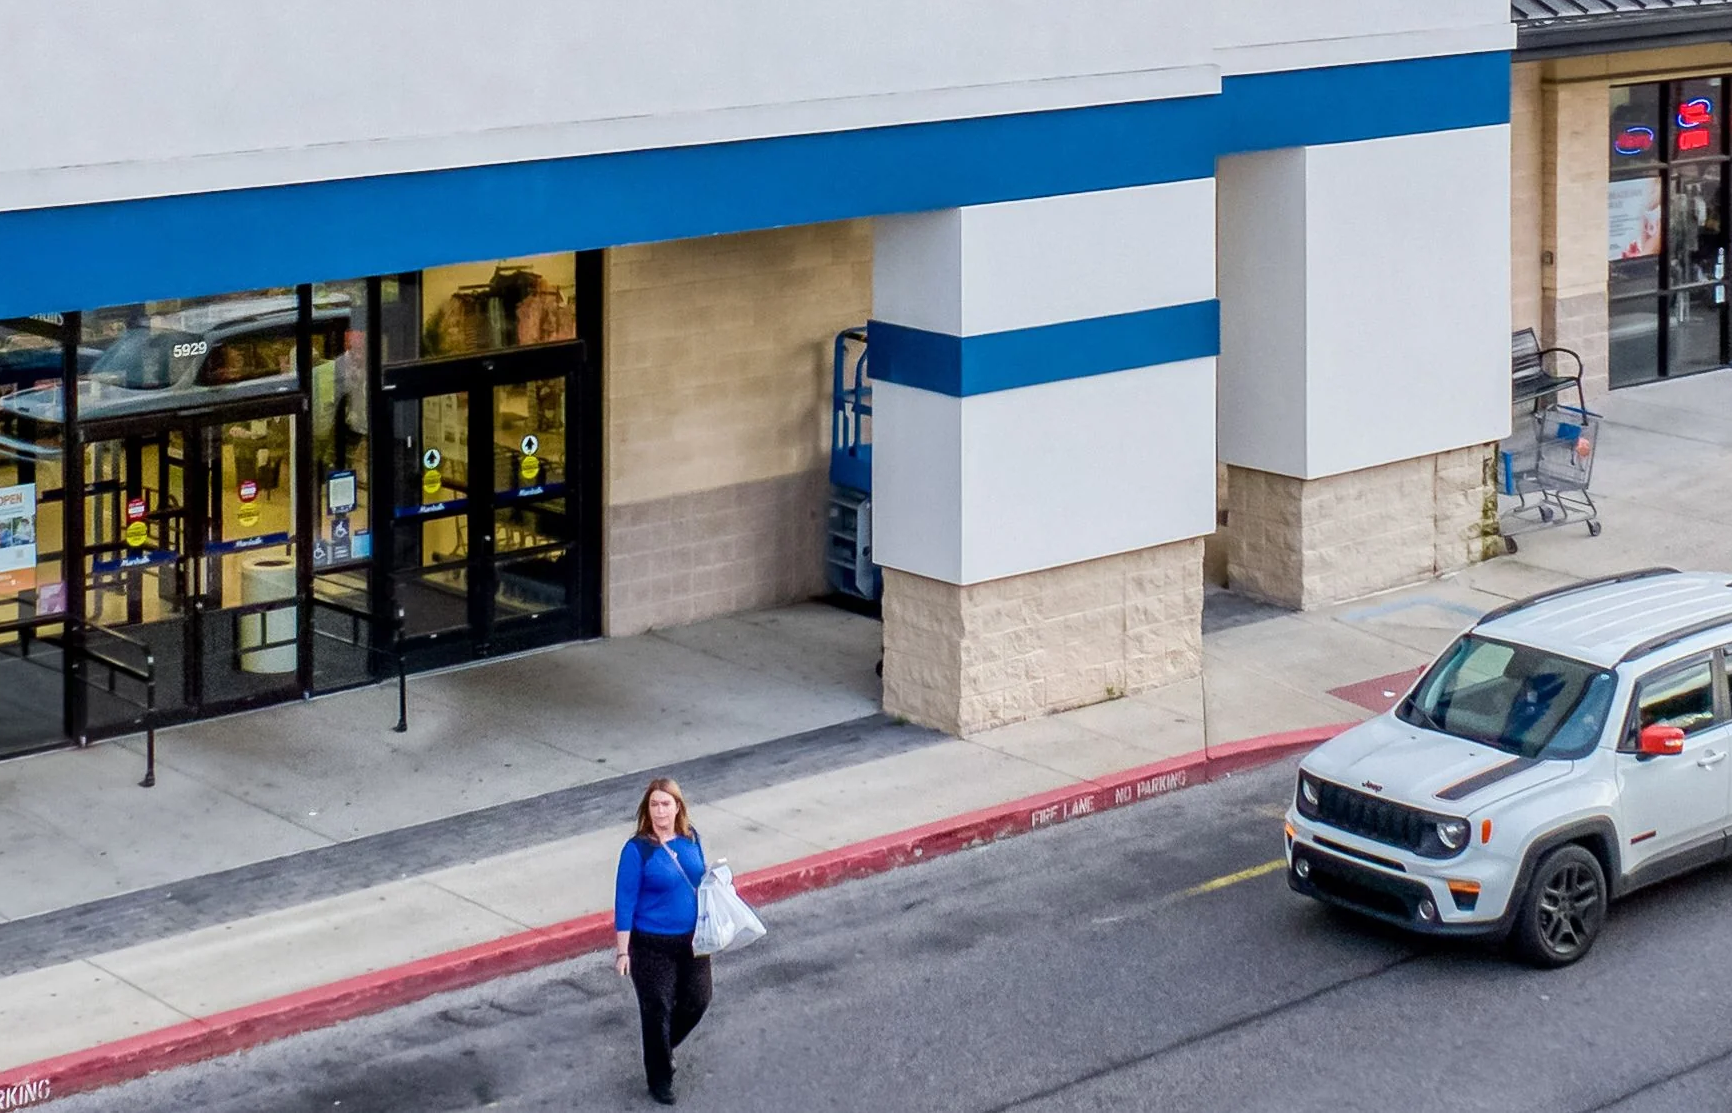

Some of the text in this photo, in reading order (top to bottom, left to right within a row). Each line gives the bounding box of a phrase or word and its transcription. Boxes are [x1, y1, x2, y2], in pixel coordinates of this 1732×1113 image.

[173, 341, 208, 358] 5929
[1031, 770, 1187, 828] FIRE LANE NO PARKING
